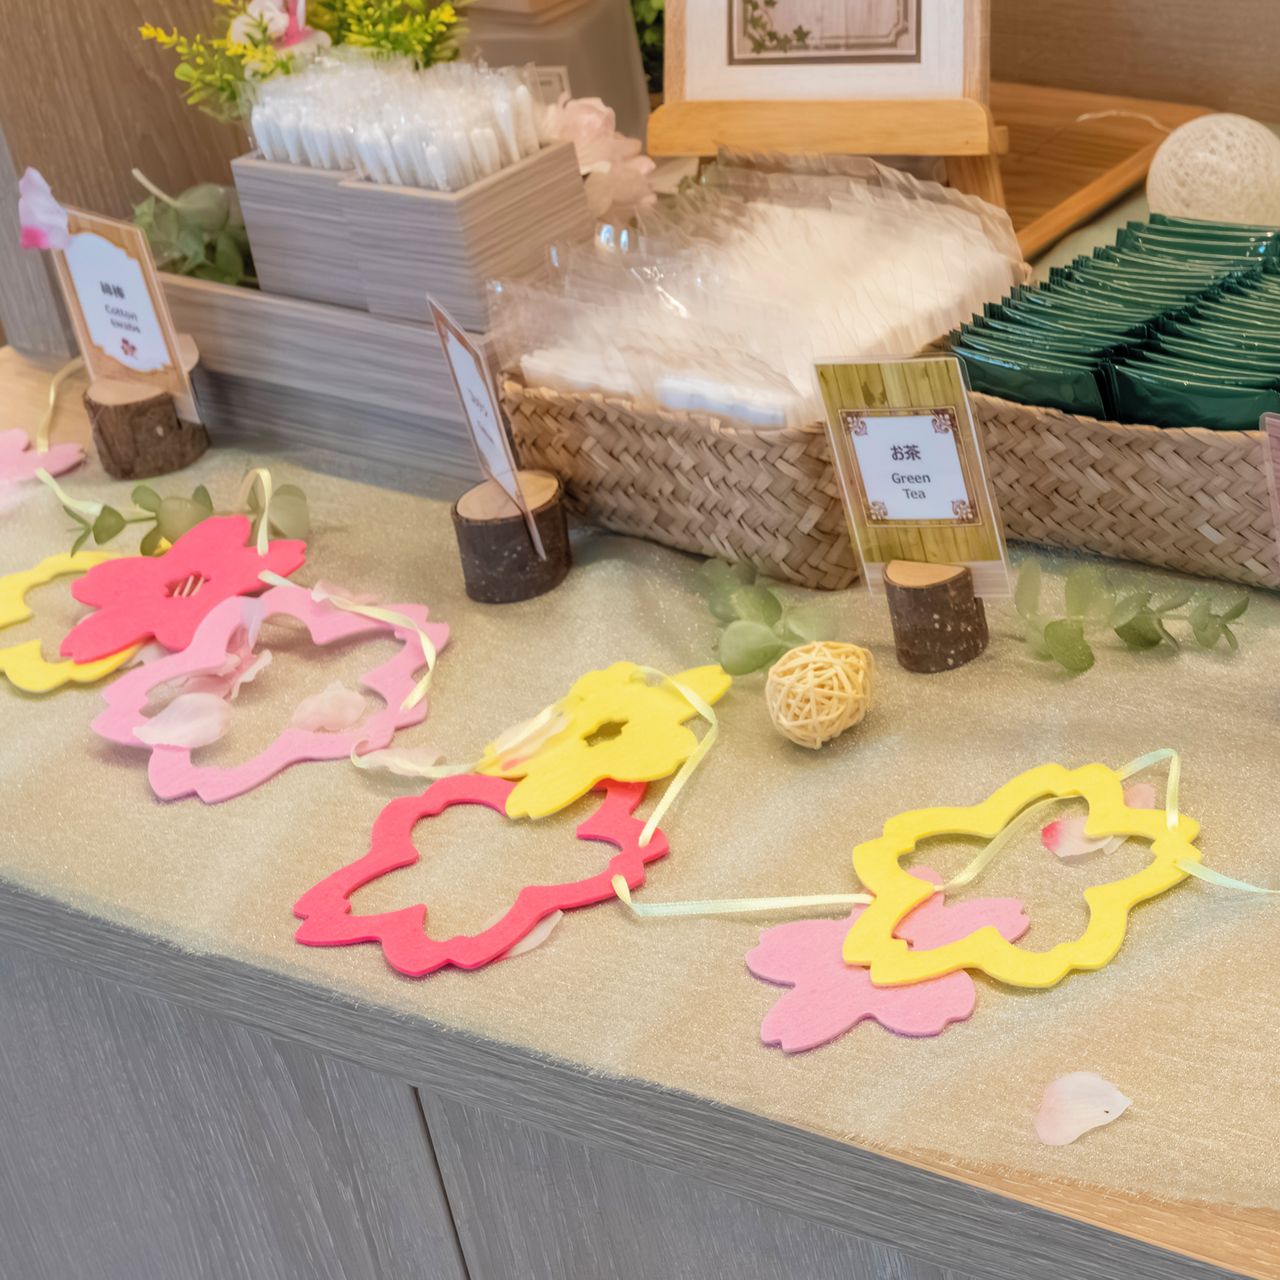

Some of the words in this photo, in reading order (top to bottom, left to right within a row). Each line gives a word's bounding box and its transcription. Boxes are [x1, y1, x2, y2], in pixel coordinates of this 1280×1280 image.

[890, 444, 922, 462] お茶
[891, 472, 931, 485] Green
[902, 488, 926, 500] Tea
